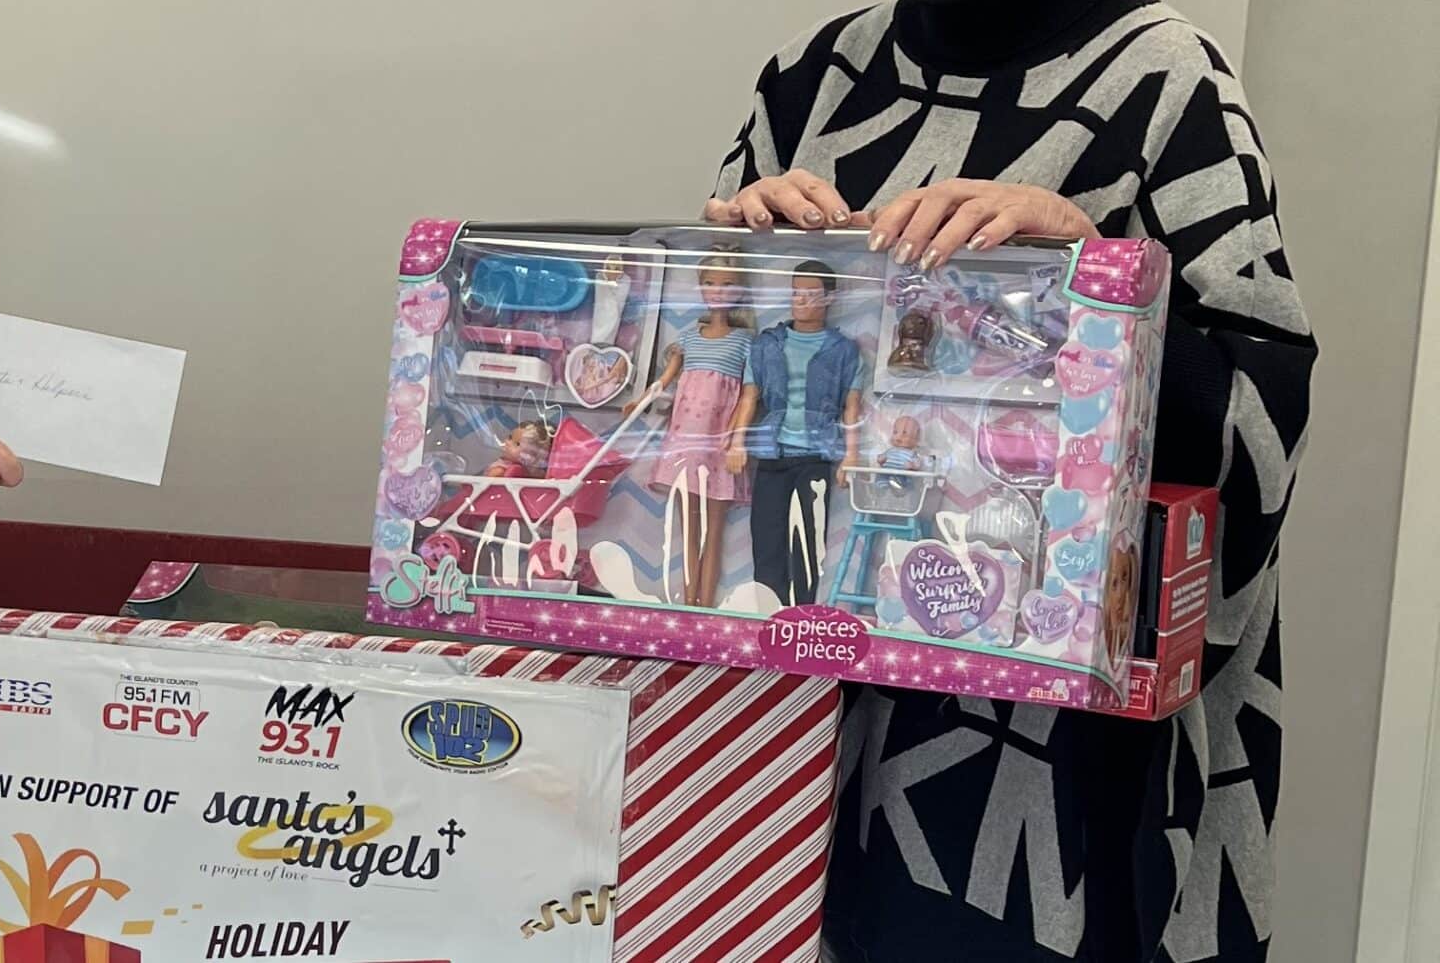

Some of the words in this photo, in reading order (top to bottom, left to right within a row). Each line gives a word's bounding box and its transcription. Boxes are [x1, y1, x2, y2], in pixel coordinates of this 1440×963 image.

[386, 559, 468, 612] Steffi
[910, 560, 983, 581] Welco
[927, 595, 983, 618] Family
[768, 623, 794, 646] 19
[797, 616, 858, 640] pieces
[795, 638, 856, 663] pièces
[124, 686, 156, 702] 95.1
[160, 689, 191, 705] FM
[264, 684, 358, 728] MAX
[103, 703, 209, 737] CFCY
[259, 720, 341, 758] 93.1
[316, 762, 340, 770] ROCK
[17, 776, 137, 810] SUPPORT
[143, 789, 179, 814] OF
[203, 790, 365, 836] santa's
[200, 863, 207, 872] a
[211, 862, 258, 879] project
[263, 865, 279, 882] of
[280, 866, 309, 882] love
[282, 834, 440, 888] angels
[206, 920, 350, 959] HOLIDAY
